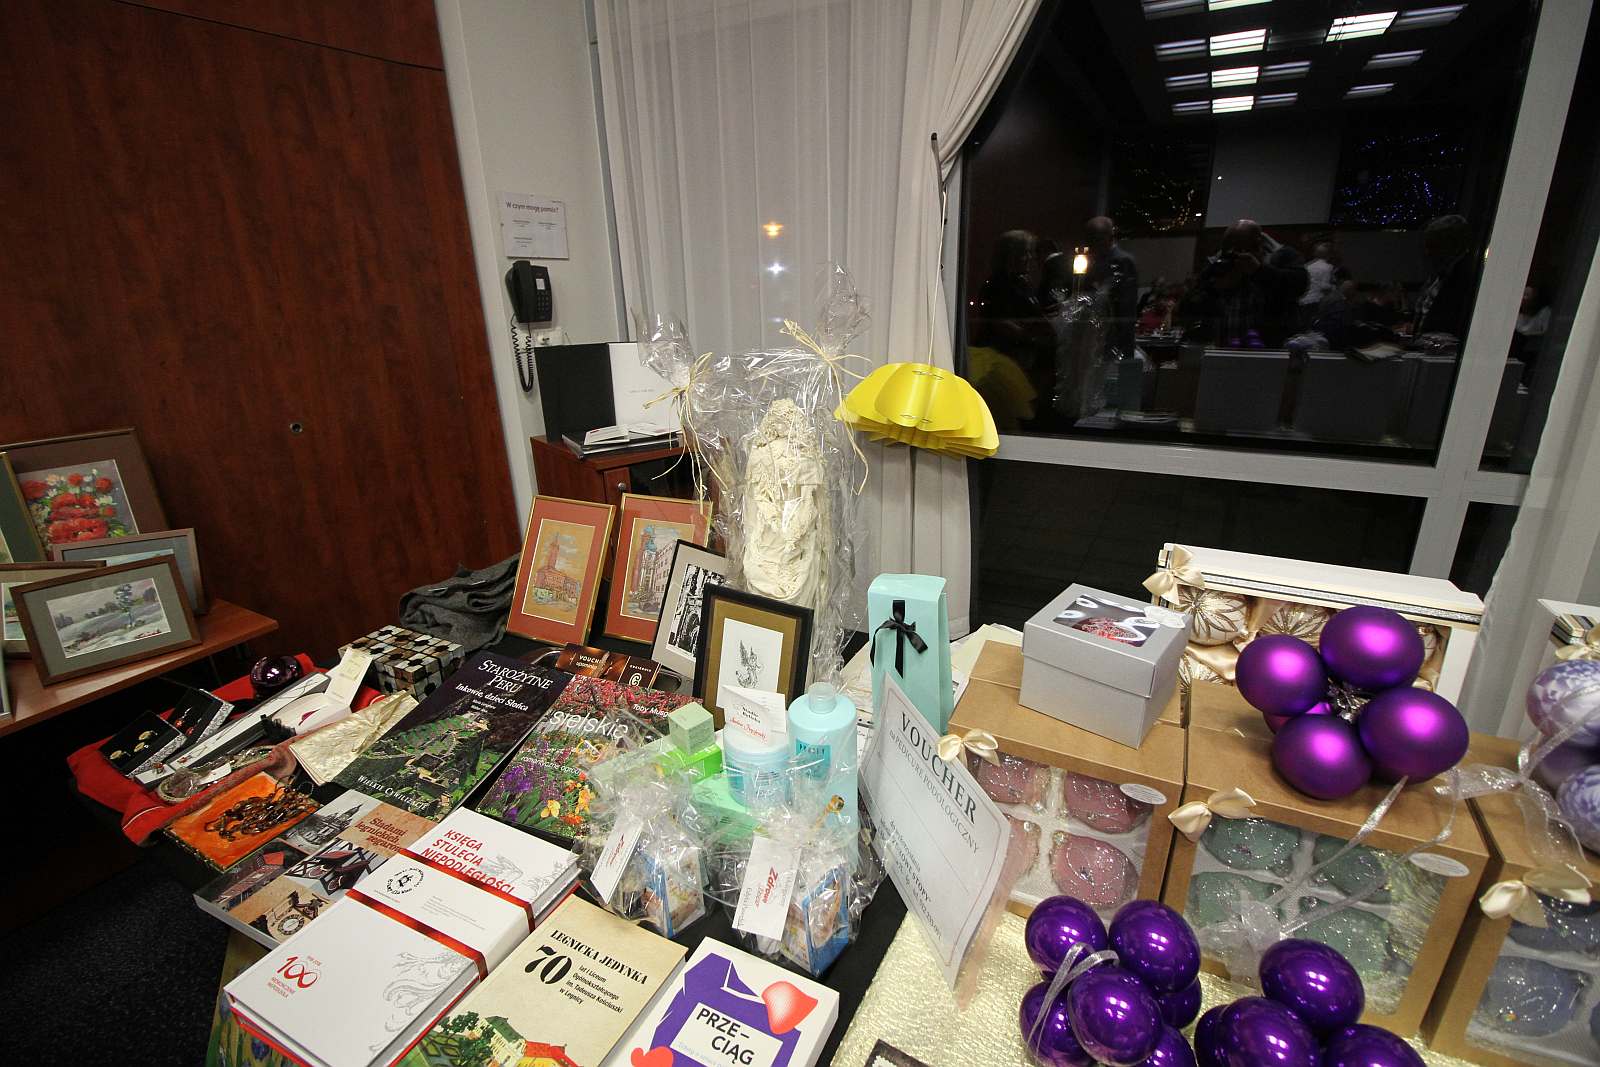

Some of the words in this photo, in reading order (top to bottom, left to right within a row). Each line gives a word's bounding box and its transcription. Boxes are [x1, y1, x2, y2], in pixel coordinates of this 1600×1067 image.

[579, 655, 604, 664] VOUCH
[455, 683, 483, 699] Inkowie,
[485, 692, 505, 707] dzieci
[505, 697, 529, 712] Słońca
[487, 676, 522, 693] PERU
[549, 708, 628, 739] sielskie
[633, 703, 648, 716] Toby
[650, 706, 669, 718] Musg
[899, 712, 977, 825] VOUCHER
[895, 737, 924, 782] PEDICURE
[923, 776, 980, 854] PODOLOGICZNY
[354, 820, 401, 844] legnickich
[443, 829, 484, 851] KSIĘGA
[432, 839, 484, 866] STULECIA
[421, 847, 515, 894] NIEPODLEGŁOŚCI
[524, 944, 572, 985] 70
[550, 930, 599, 963] LEGNICKA
[599, 955, 649, 985] JEDYNKA
[579, 965, 587, 973] lat
[589, 970, 607, 983] Liceum
[565, 989, 584, 1005] Legnicy
[574, 984, 596, 1000] Tadeusza
[596, 995, 623, 1014] Kościuszki
[711, 1035, 755, 1065] CIĄG
